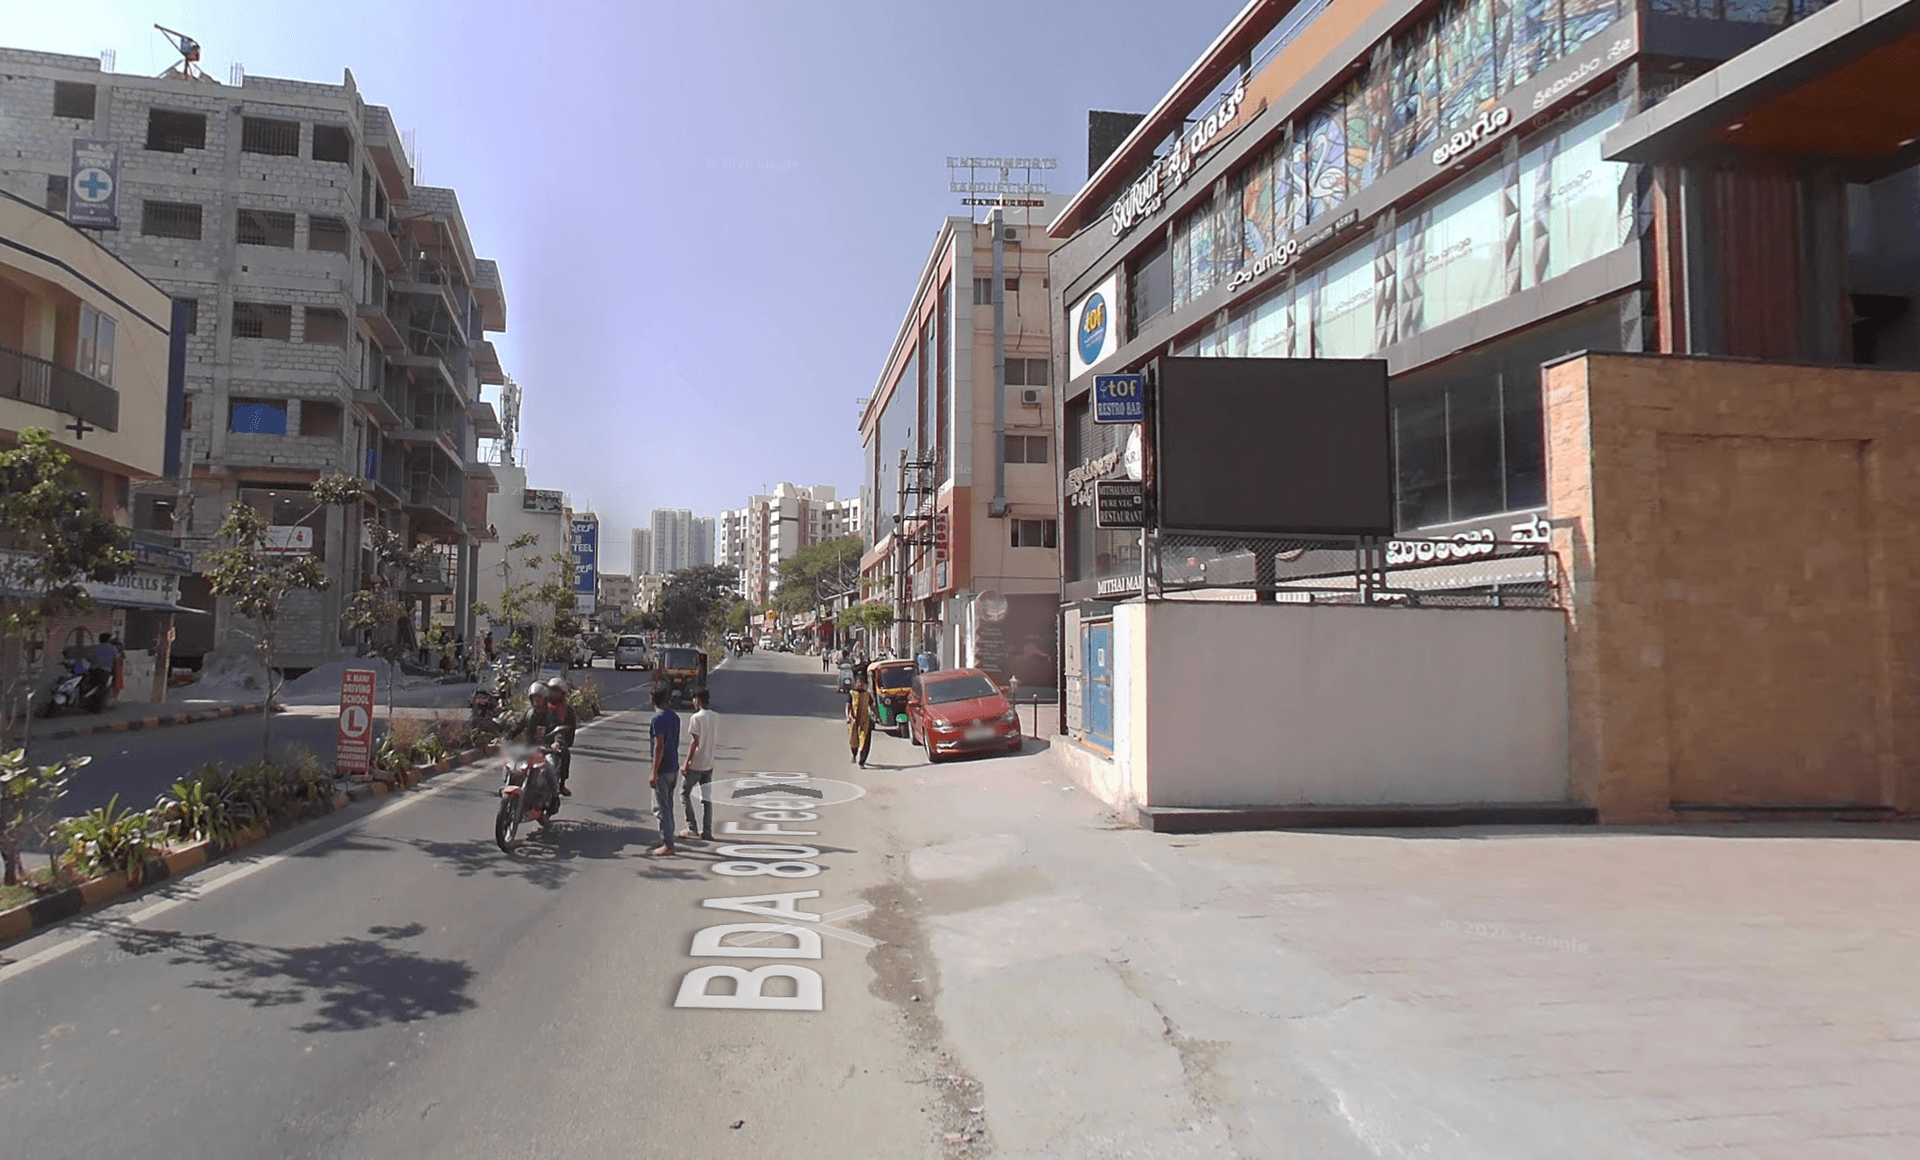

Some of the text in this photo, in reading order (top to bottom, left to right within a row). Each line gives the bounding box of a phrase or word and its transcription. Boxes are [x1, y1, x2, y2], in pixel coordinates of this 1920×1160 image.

[1254, 240, 1297, 275] amigo
[1108, 380, 1137, 398] tof
[572, 543, 594, 553] TEEL
[343, 694, 370, 705] SCHOOL
[347, 709, 363, 732] L
